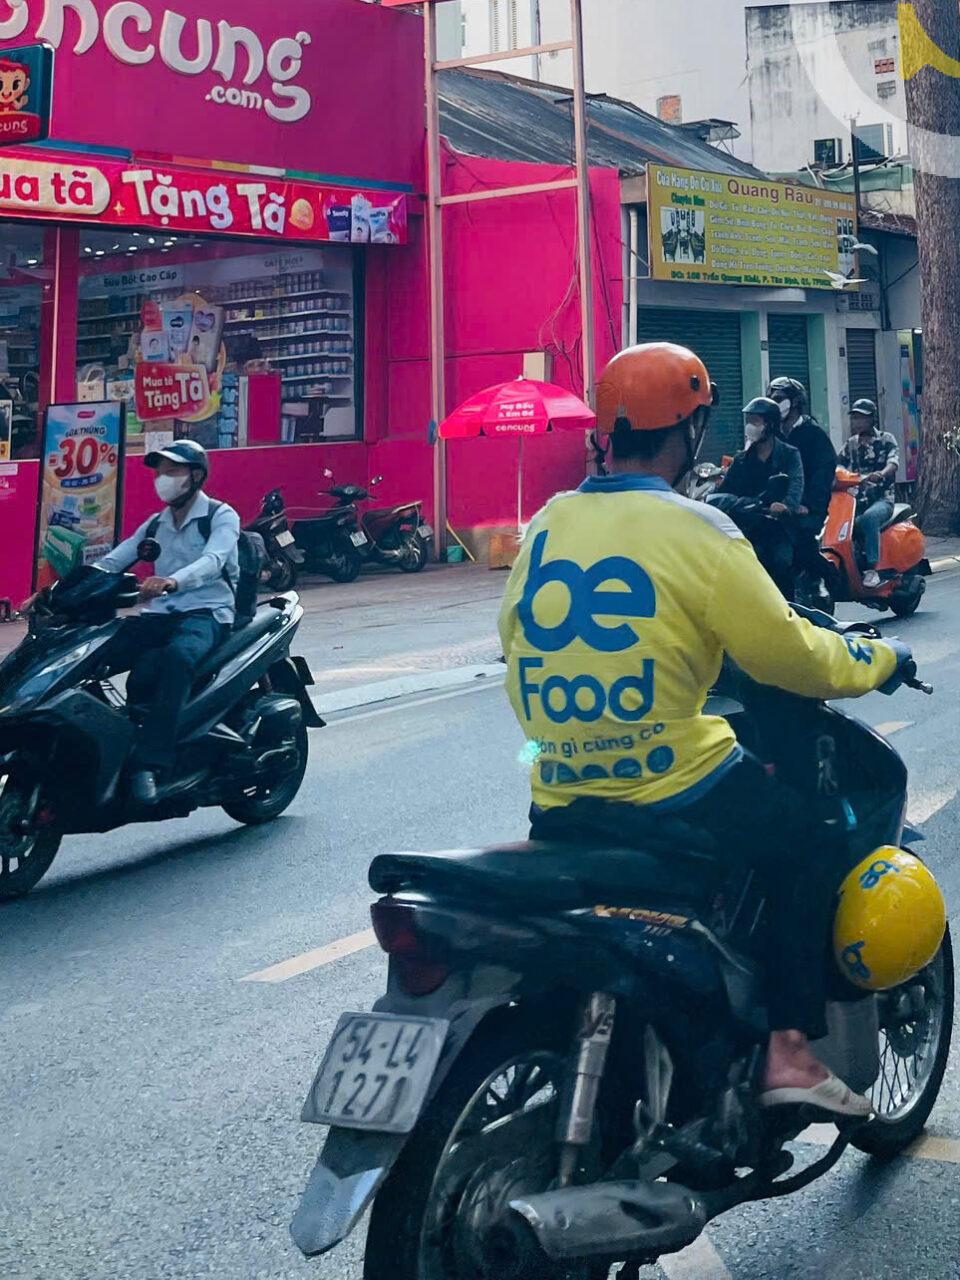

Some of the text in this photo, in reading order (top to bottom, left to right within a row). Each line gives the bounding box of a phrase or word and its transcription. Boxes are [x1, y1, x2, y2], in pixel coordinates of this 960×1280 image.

[205, 85, 263, 111] .com
[51, 170, 94, 207] tã
[122, 169, 231, 230] Tặng
[236, 183, 286, 235] Tã
[727, 178, 780, 203] Quang
[143, 376, 163, 388] Mua
[144, 372, 204, 411] Tặng Tã
[517, 530, 656, 652] be
[517, 656, 655, 722] Food
